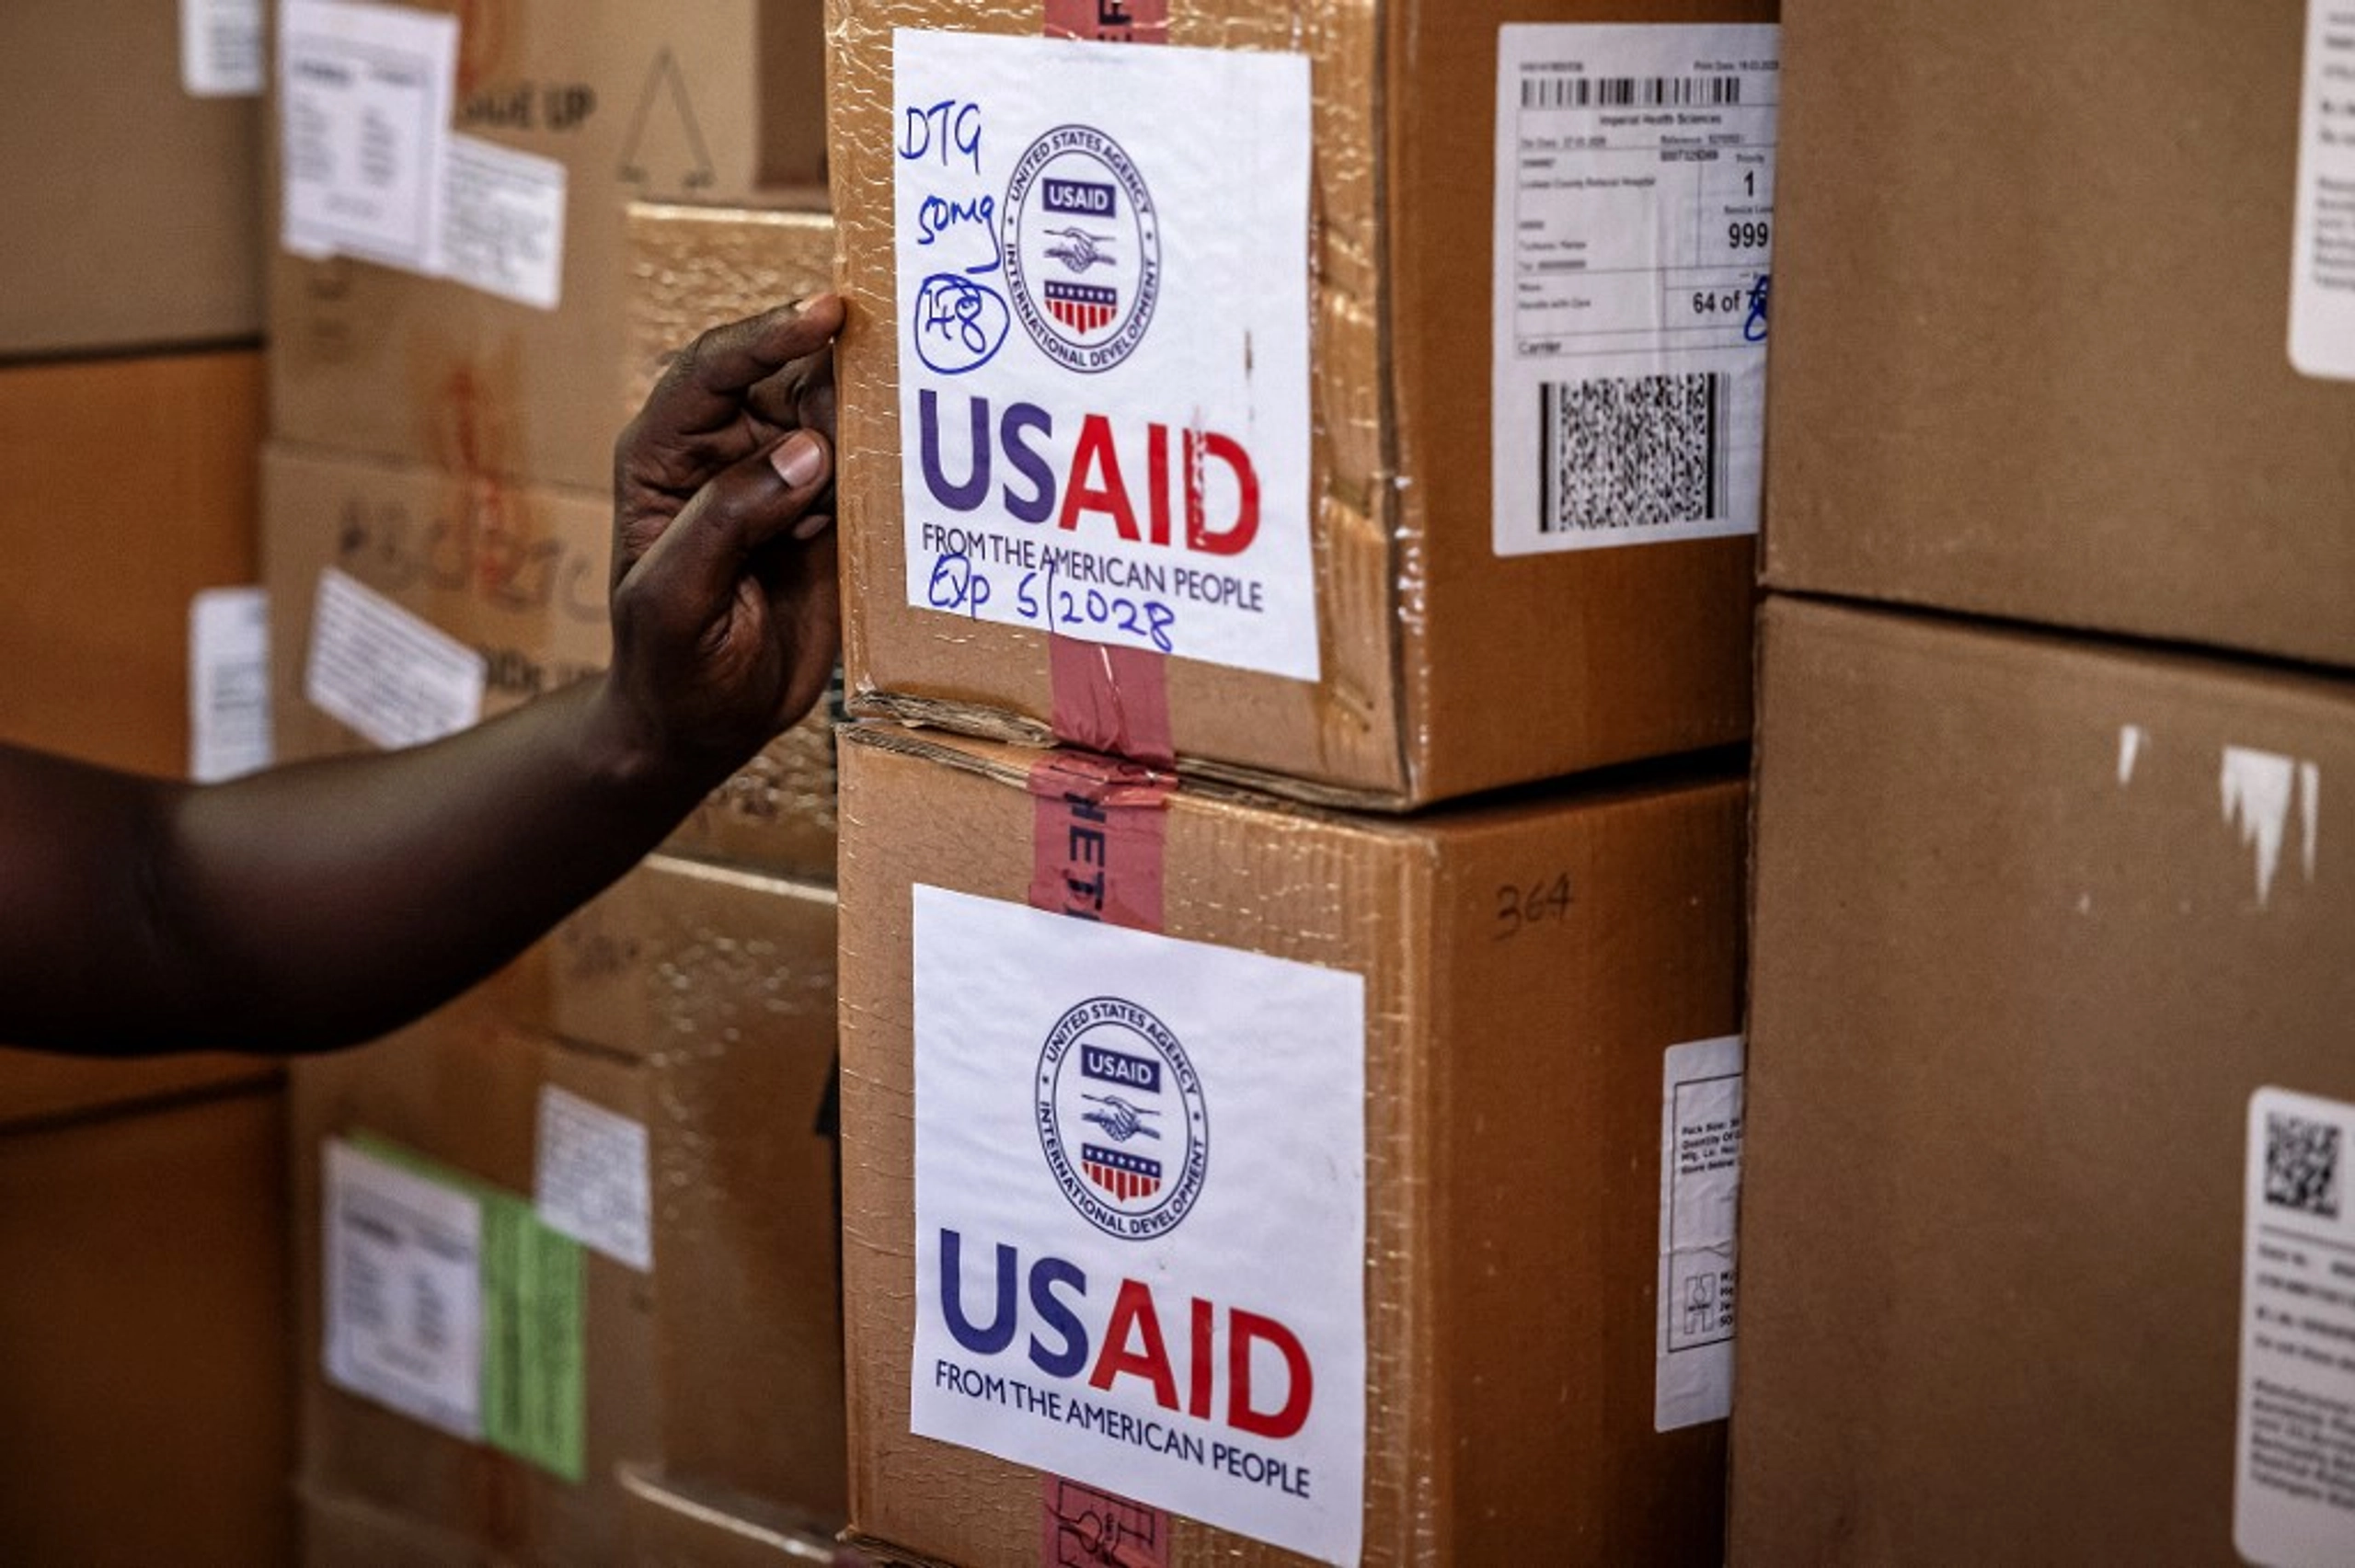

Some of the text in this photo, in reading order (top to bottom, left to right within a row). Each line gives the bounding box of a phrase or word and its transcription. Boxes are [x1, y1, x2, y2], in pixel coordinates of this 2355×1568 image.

[899, 100, 982, 175] DTG
[1642, 114, 1674, 126] Health
[1677, 112, 1722, 125] Sciences
[1011, 131, 1151, 214] UNITED STATES AGENCY
[1048, 185, 1109, 212] USAID
[1744, 170, 1754, 197] 1
[1729, 222, 1768, 249] 999
[1005, 243, 1156, 368] INTERNATIONAL DEVELOPMENT
[1693, 291, 1715, 315] 64
[1721, 289, 1740, 314] of
[919, 388, 1260, 556] USAID
[922, 521, 1264, 613] FROM THE AMERICAN PEOPLE
[1063, 791, 1107, 921] HET
[1490, 872, 1574, 942] 364
[1046, 1002, 1198, 1095] UNITED STATES AGENCY
[1088, 1053, 1154, 1085] USAID
[1040, 1101, 1204, 1235] INTERNATIONAL DEVELOPMENT
[1682, 1136, 1719, 1151] Quantity
[940, 1228, 1314, 1441] USAID
[936, 1358, 1311, 1500] FROM THE AMERICAN PEOPLE
